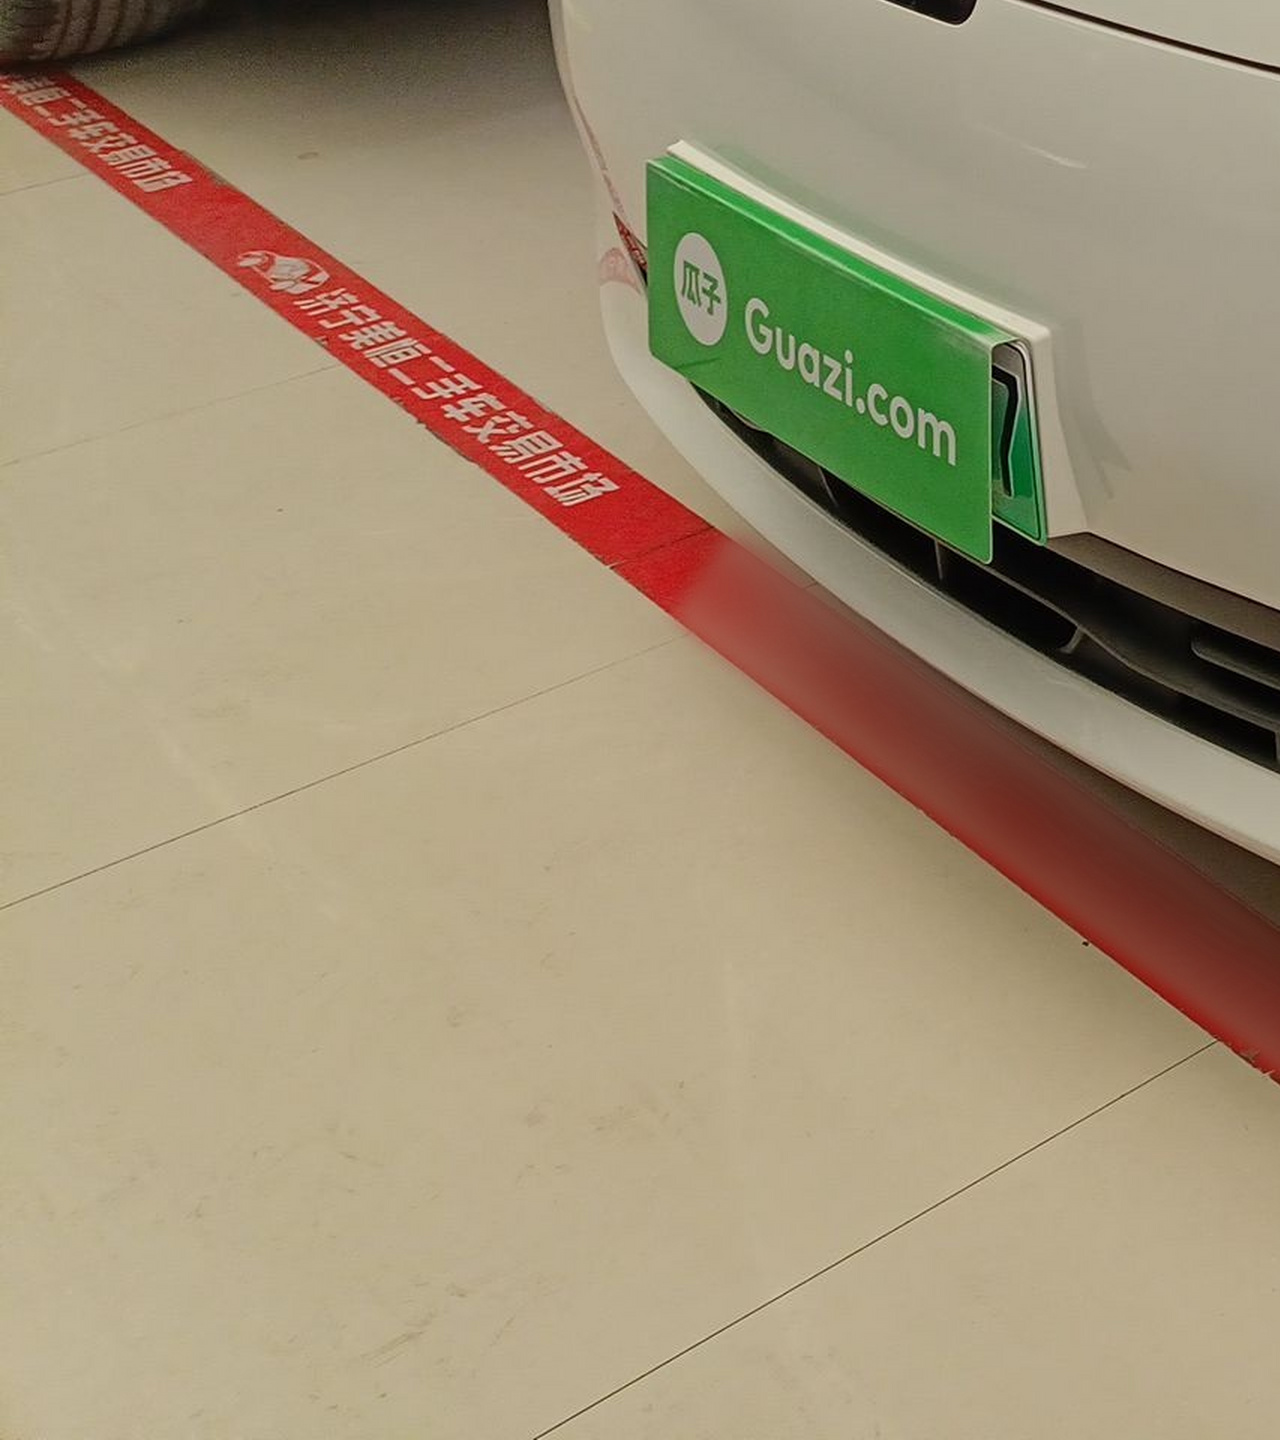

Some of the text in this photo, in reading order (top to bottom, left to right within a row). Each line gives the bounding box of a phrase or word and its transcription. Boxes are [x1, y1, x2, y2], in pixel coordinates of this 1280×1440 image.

[681, 259, 723, 317] 瓜子
[293, 287, 621, 508] 济宁美恒二手车交易市场
[743, 297, 958, 468] Guazi.com
